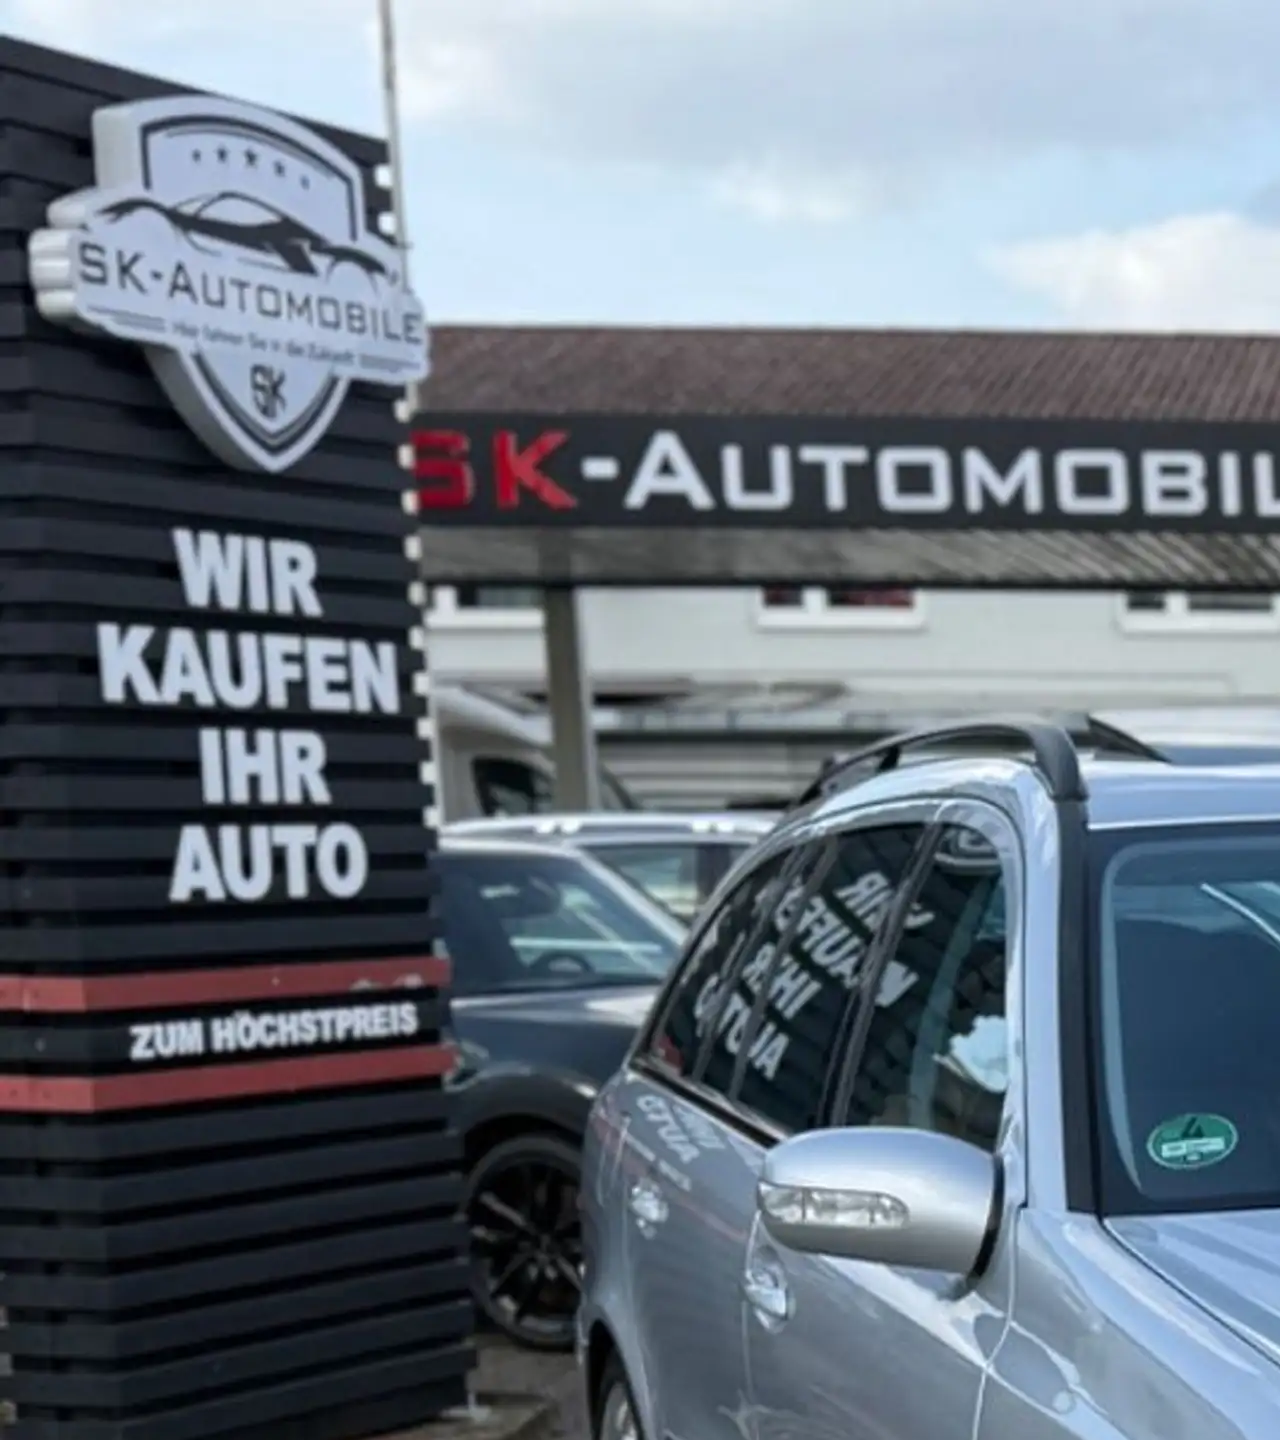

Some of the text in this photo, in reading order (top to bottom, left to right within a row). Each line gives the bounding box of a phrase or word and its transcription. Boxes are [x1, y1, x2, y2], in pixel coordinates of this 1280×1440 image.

[78, 242, 424, 345] SK-AUTOMOBILE
[172, 528, 323, 616] WIR
[97, 622, 400, 714] KAUFEN
[199, 727, 331, 804] IHR
[169, 823, 368, 902] AUTO
[130, 1002, 418, 1061] ZUM HÖCHSTPREIS
